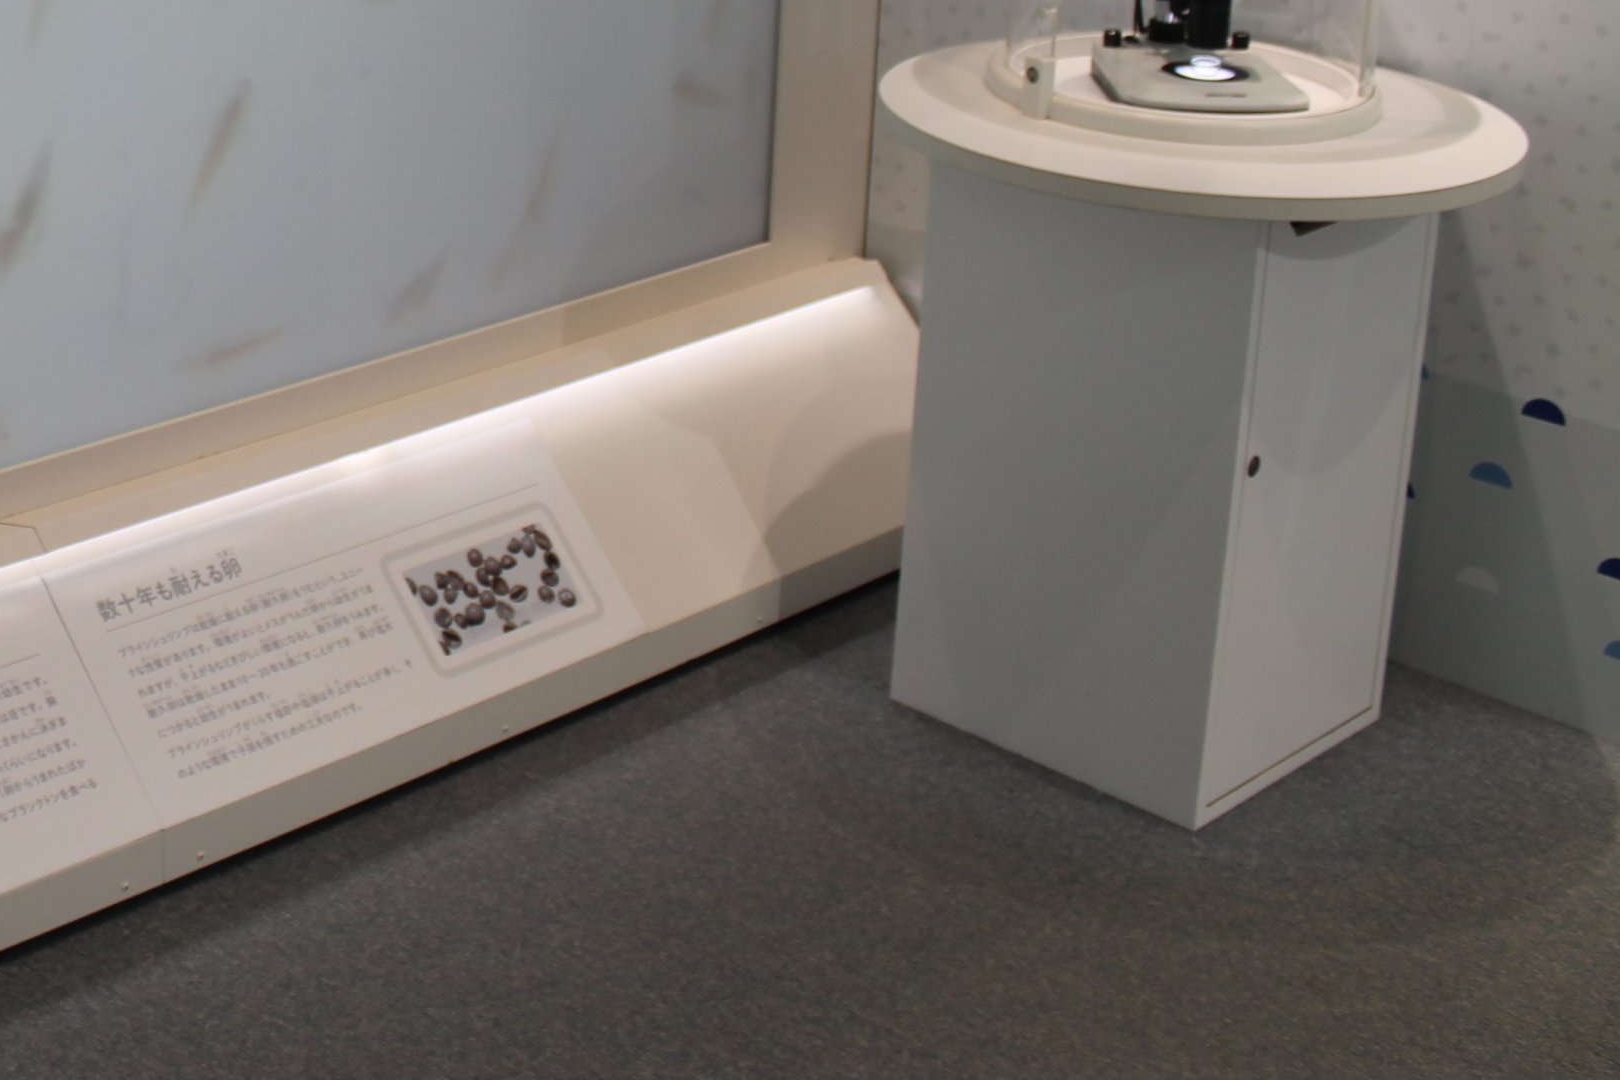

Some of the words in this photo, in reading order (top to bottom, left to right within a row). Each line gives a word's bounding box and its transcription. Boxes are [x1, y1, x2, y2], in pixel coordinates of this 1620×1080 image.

[96, 558, 242, 622] 数十年も耐える卵
